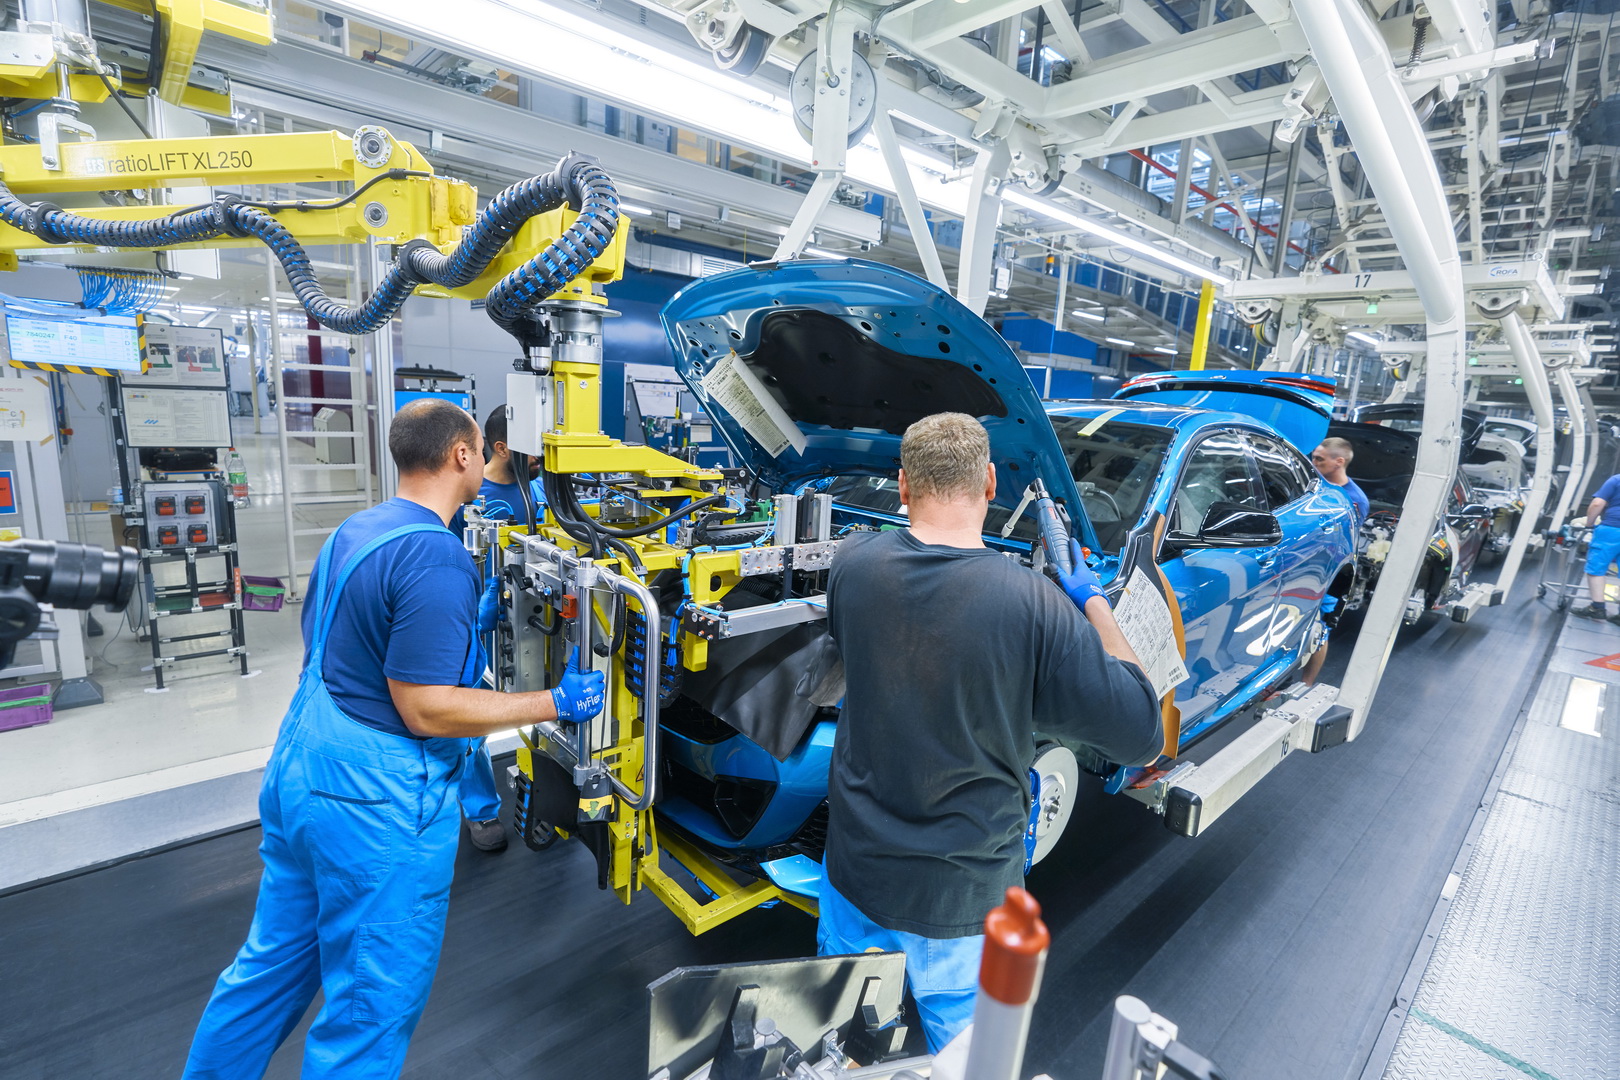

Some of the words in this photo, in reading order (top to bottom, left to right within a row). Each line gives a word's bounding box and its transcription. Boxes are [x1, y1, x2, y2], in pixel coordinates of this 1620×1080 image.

[86, 159, 104, 172] EFS
[192, 150, 253, 170] XL250
[1354, 274, 1371, 288] 17
[1281, 732, 1290, 757] 16
